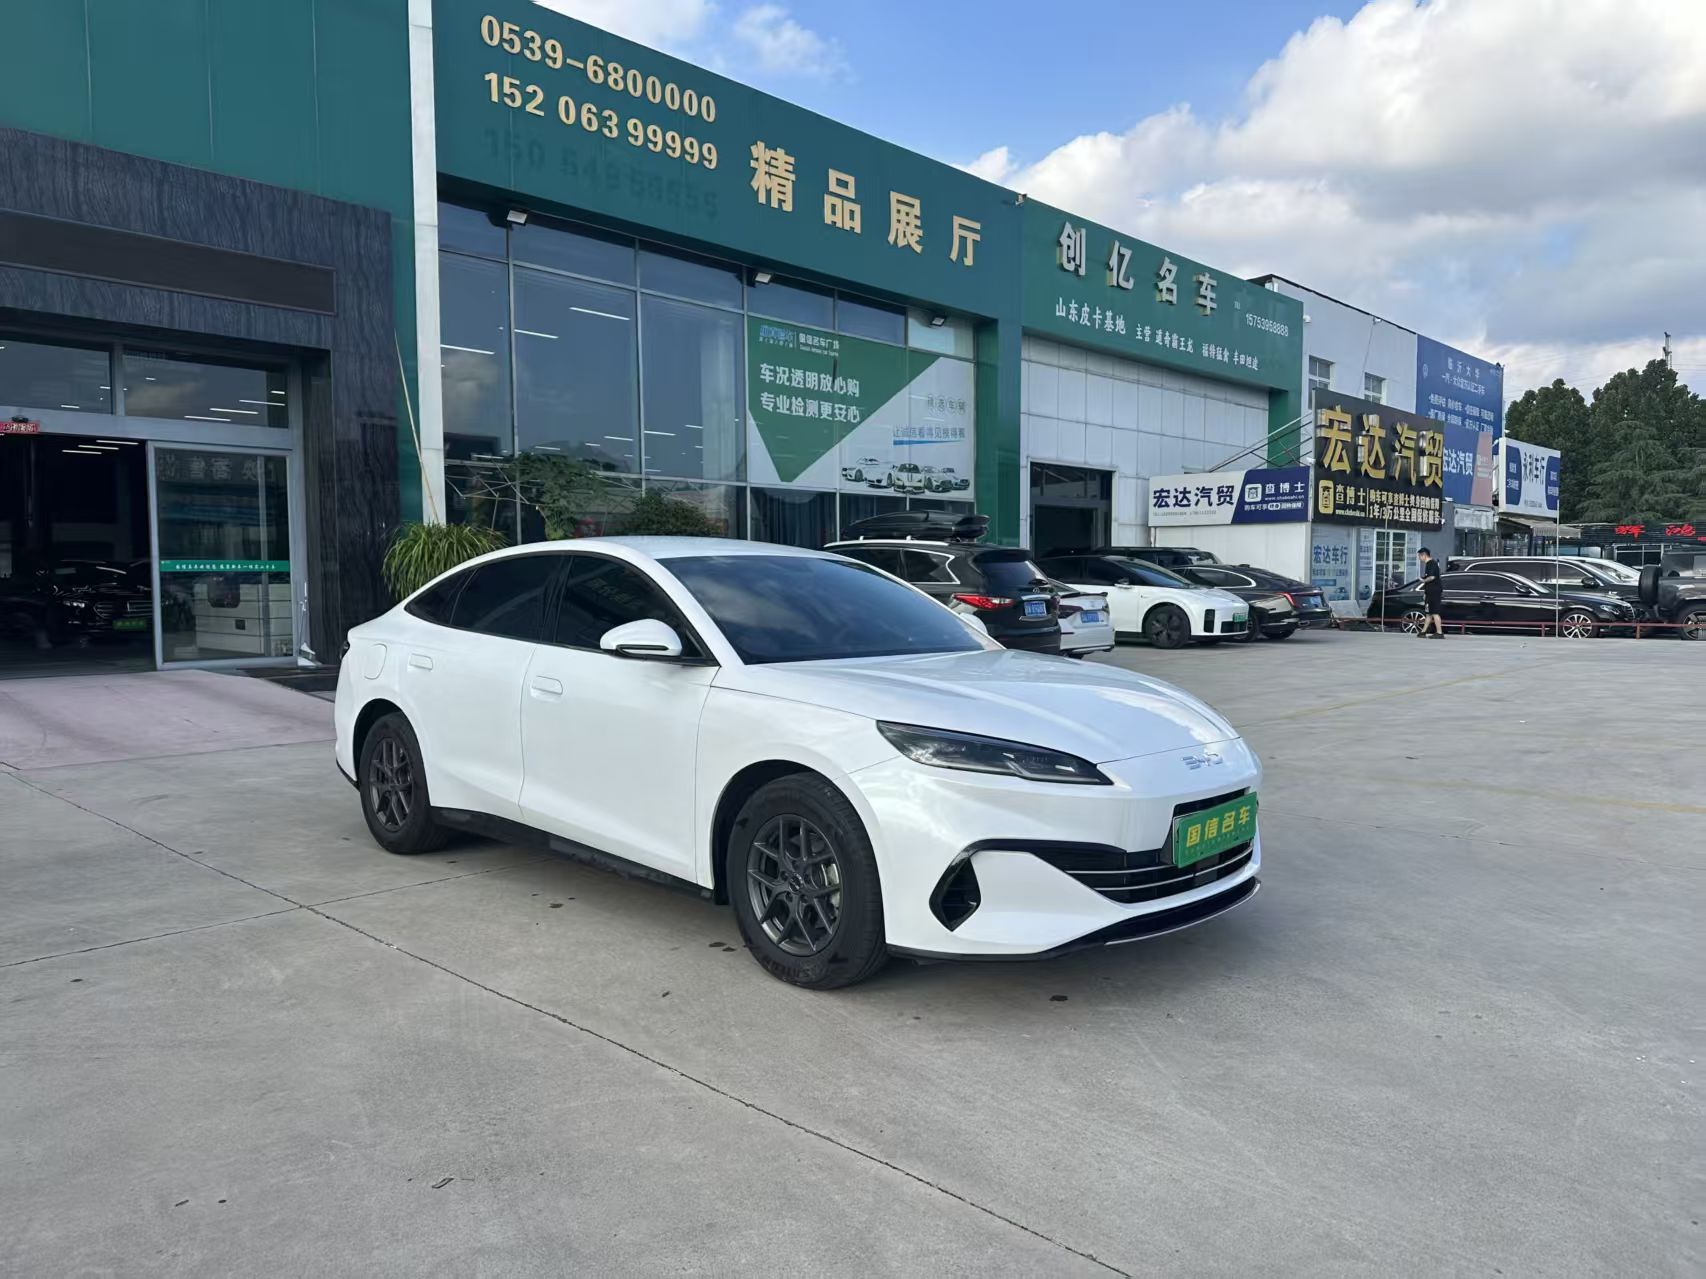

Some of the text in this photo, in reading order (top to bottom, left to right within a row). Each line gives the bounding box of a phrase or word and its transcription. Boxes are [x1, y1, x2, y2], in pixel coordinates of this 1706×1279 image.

[481, 15, 717, 123] 0539-6800000
[483, 72, 718, 170] 152 063 99999
[750, 140, 981, 266] 精品展厅
[1057, 221, 1217, 316] 创亿名车
[1056, 297, 1126, 335] 山东皮卡基地
[1136, 324, 1151, 342] 主营
[760, 363, 860, 398] 车况透明放心购
[760, 392, 860, 424] 专业检测更安心
[1317, 404, 1443, 489] 宏达汽贸
[1153, 485, 1235, 509] 宏达汽贸
[1265, 481, 1305, 495] 查博士
[1336, 483, 1366, 506] 查博士
[1313, 544, 1348, 565] 宏达车行
